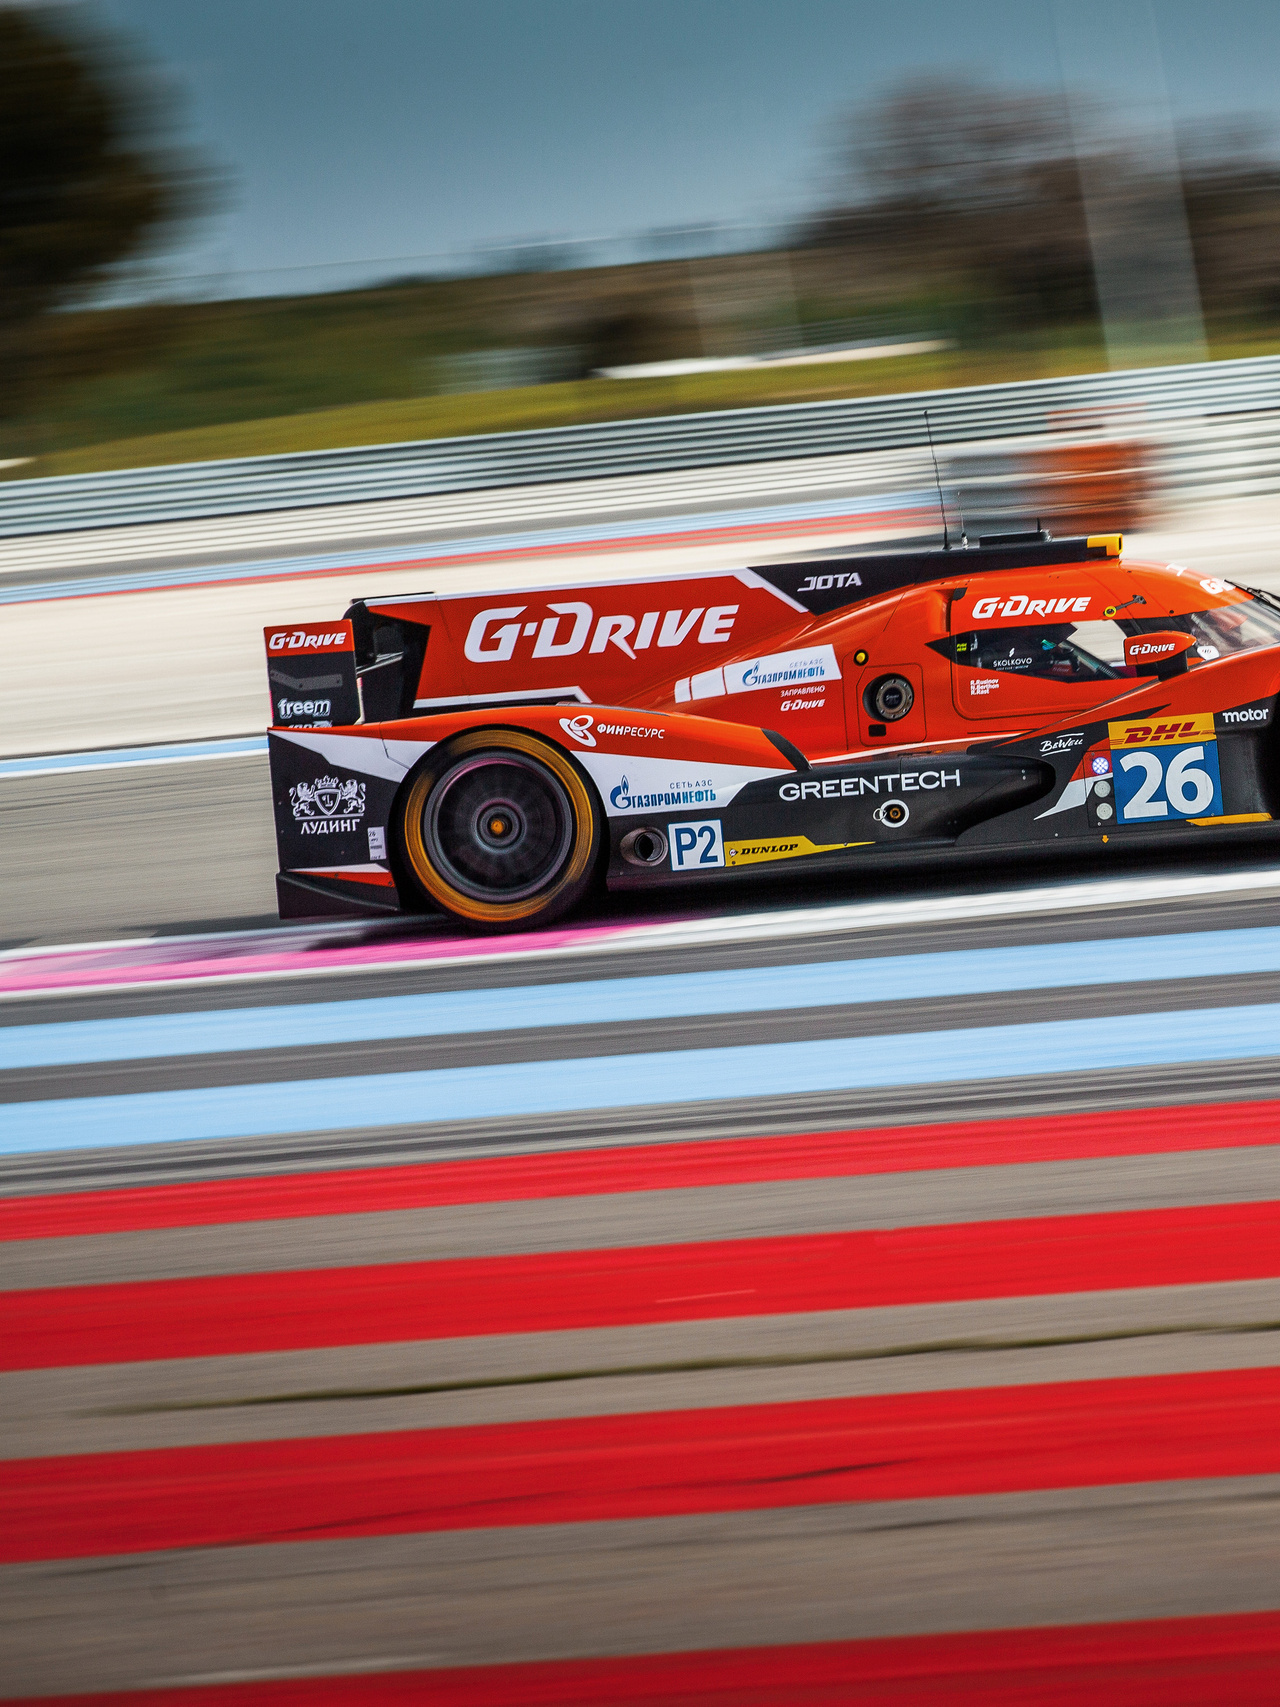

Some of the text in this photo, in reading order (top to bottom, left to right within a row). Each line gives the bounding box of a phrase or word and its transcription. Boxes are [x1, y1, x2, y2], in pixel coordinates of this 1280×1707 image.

[797, 572, 863, 592] JOTA
[993, 657, 1032, 667] SKOLKOVO
[757, 666, 825, 684] ГАЗПРОМНЕФТЬ
[781, 685, 825, 697] ЗАПРАВЛЕНО
[278, 698, 332, 719] freem
[1222, 708, 1269, 723] motor
[596, 723, 665, 739] ФИНРЕСУРС
[1124, 721, 1200, 744] DHL
[669, 779, 713, 790] СЕТЬ АЗС
[779, 769, 961, 801] GREENTECH
[1119, 746, 1214, 819] 26
[632, 789, 717, 809] ГАЗПРОМНЕФТЬ
[300, 818, 361, 835] ЛУДИНГ
[674, 825, 719, 866] P2
[740, 843, 799, 856] DUNLOP
